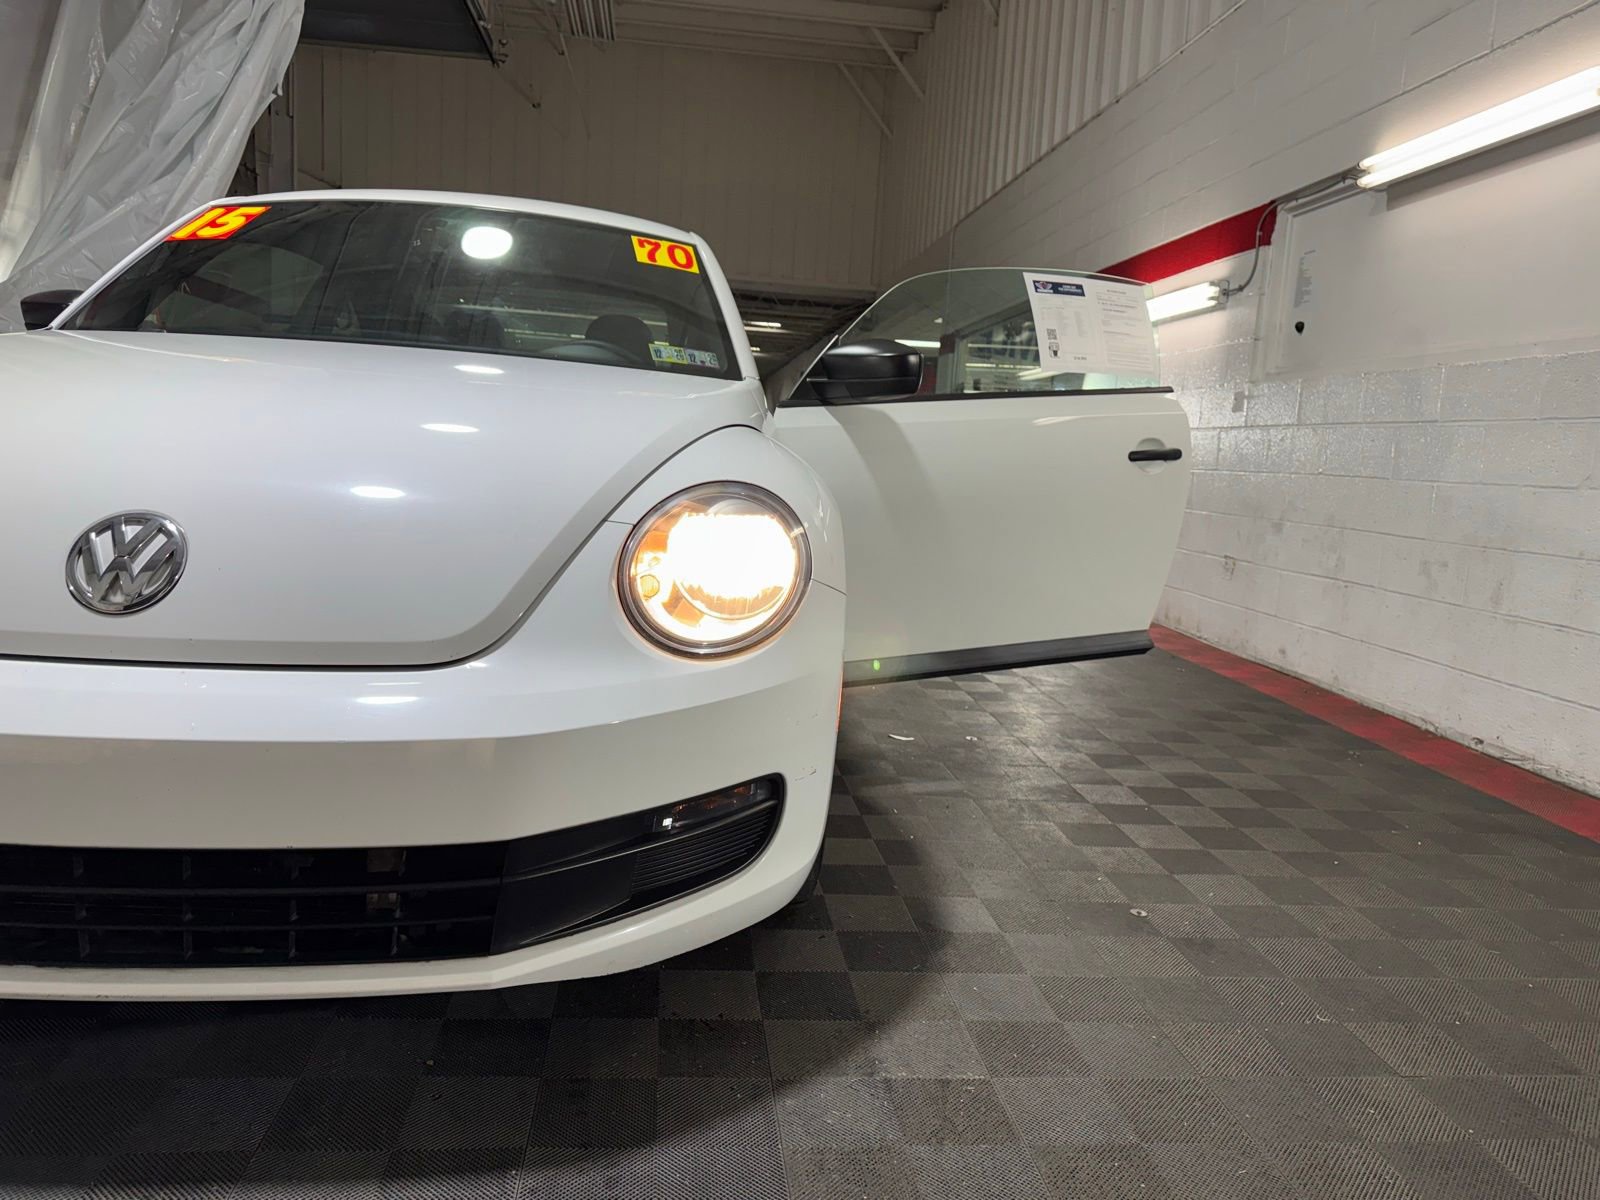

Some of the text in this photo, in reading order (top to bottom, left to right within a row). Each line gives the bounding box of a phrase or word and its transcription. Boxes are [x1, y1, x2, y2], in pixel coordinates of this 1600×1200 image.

[171, 206, 267, 238] 15
[637, 238, 694, 270] 70
[654, 348, 662, 359] 12
[74, 513, 180, 609] VW
